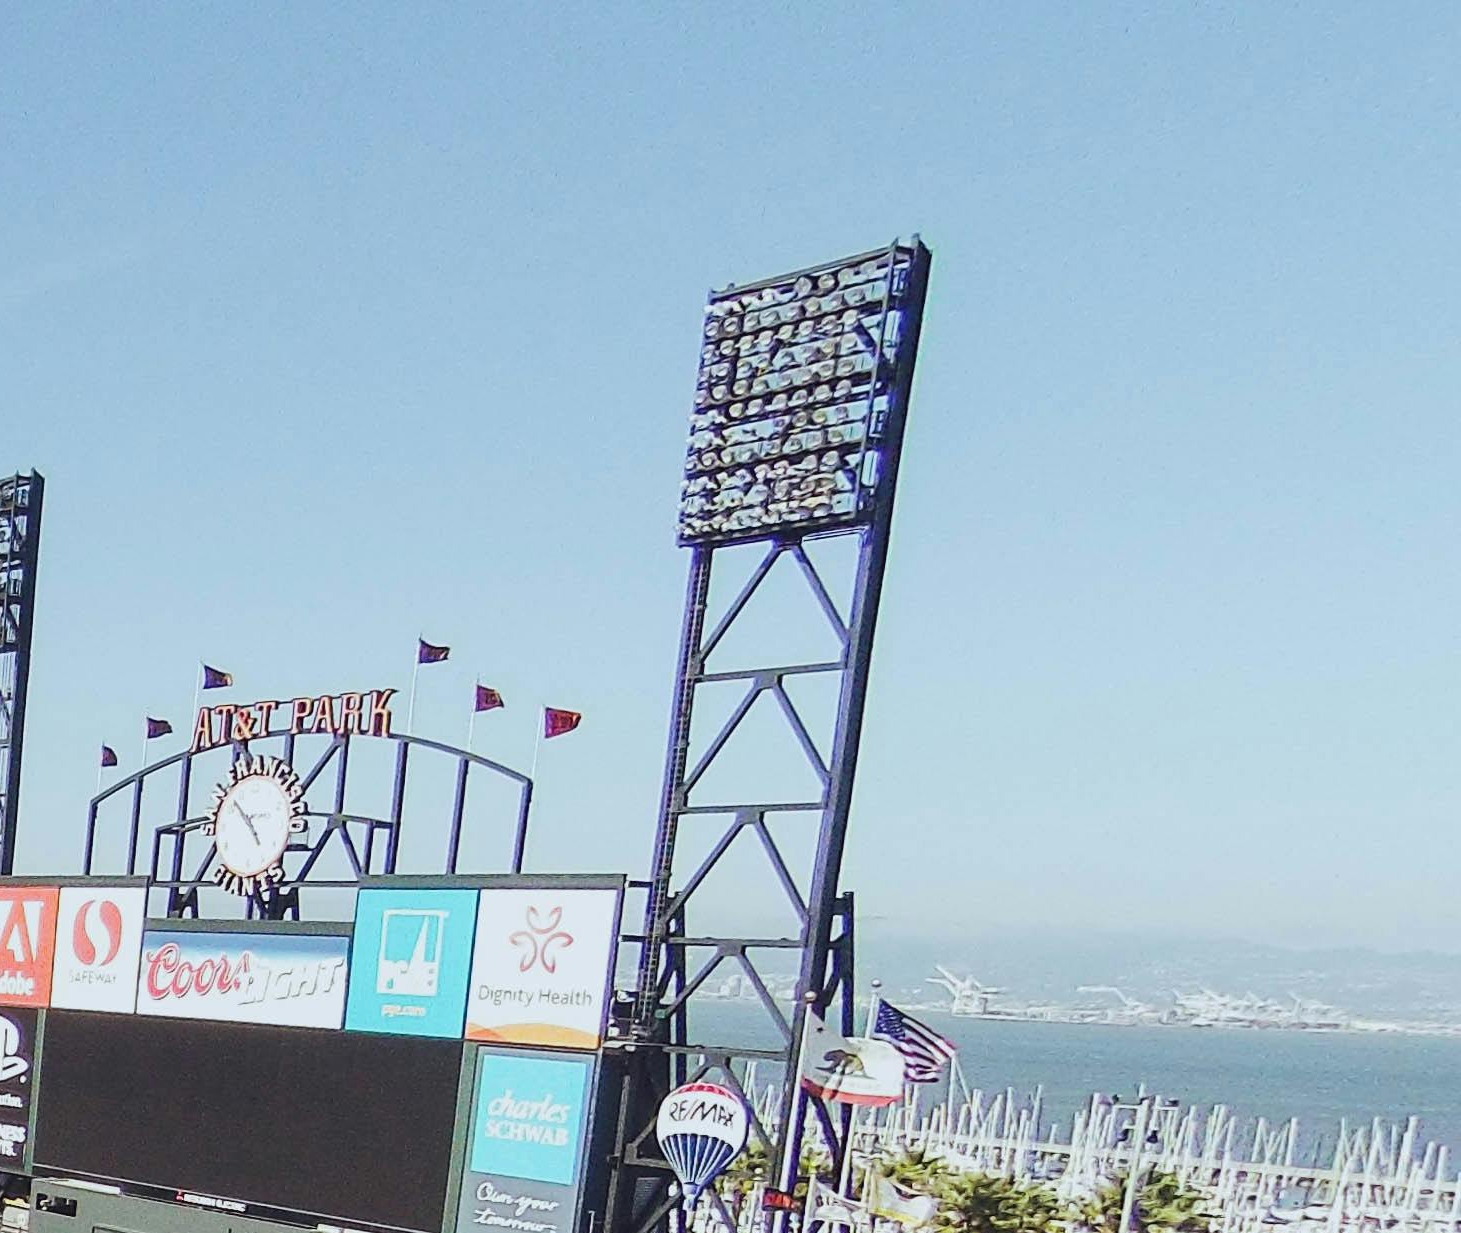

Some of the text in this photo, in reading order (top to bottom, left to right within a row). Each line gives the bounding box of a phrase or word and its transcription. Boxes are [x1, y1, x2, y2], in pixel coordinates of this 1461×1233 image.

[189, 688, 400, 753] AT&T PARK
[228, 754, 310, 834] FRANCISCO
[213, 862, 285, 899] GIANTS
[68, 969, 118, 986] SAFEWAY
[146, 941, 345, 1006] Coors LIGHT
[477, 984, 593, 1007] Dignity Health
[487, 1088, 571, 1125] charles
[668, 1101, 737, 1129] RE/MAX
[484, 1116, 569, 1146] SCHWAB
